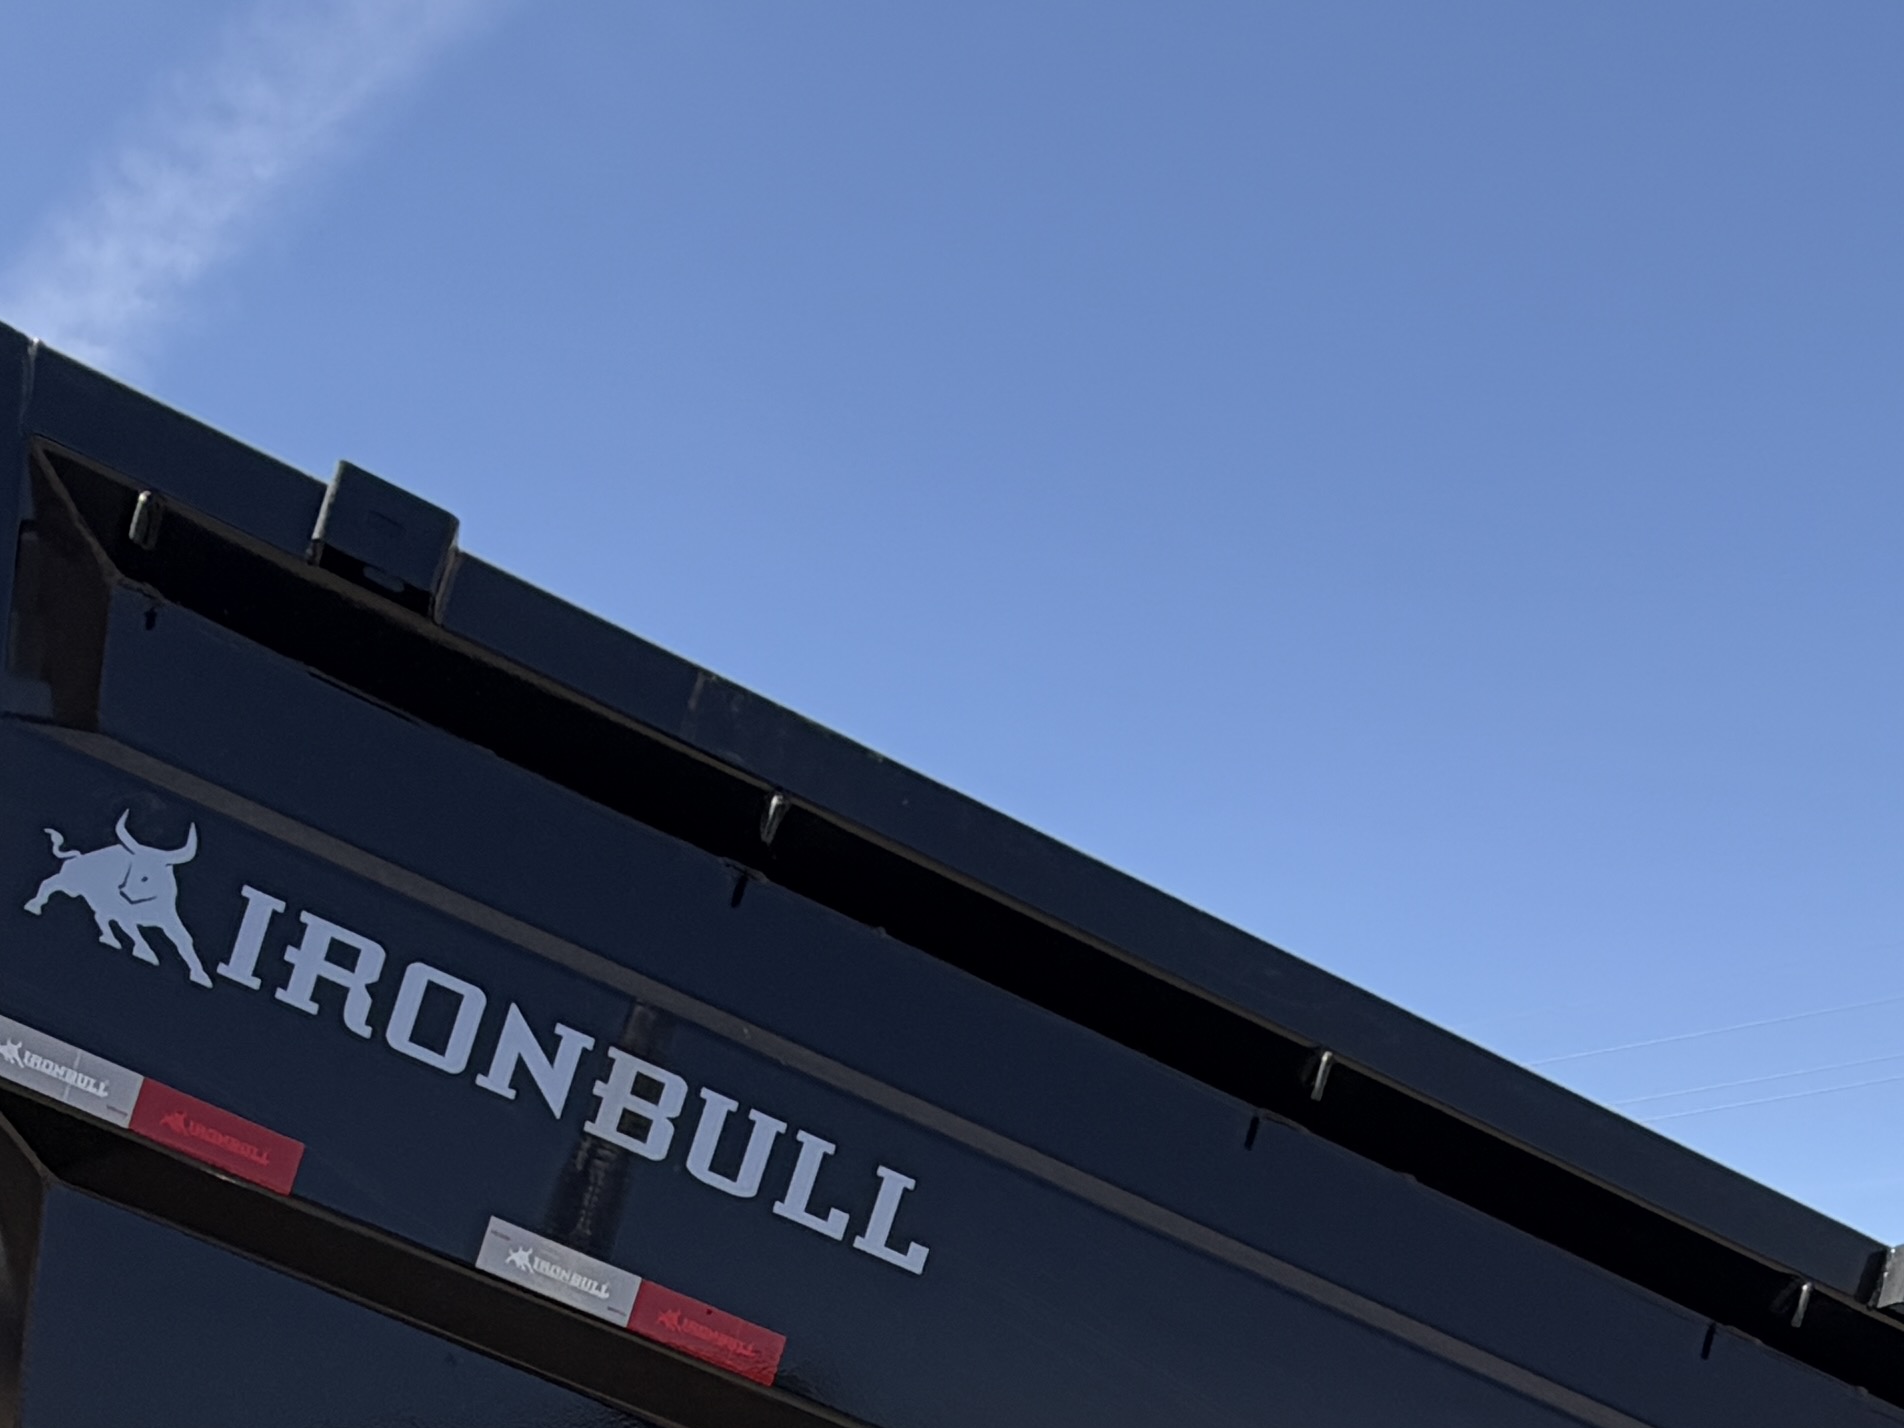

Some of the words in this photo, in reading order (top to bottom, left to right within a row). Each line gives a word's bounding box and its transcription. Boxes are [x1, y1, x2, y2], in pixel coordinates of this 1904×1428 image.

[22, 1049, 110, 1099] IRONBULL
[217, 885, 930, 1276] IRONBULL
[533, 1256, 610, 1300] IRONBULL
